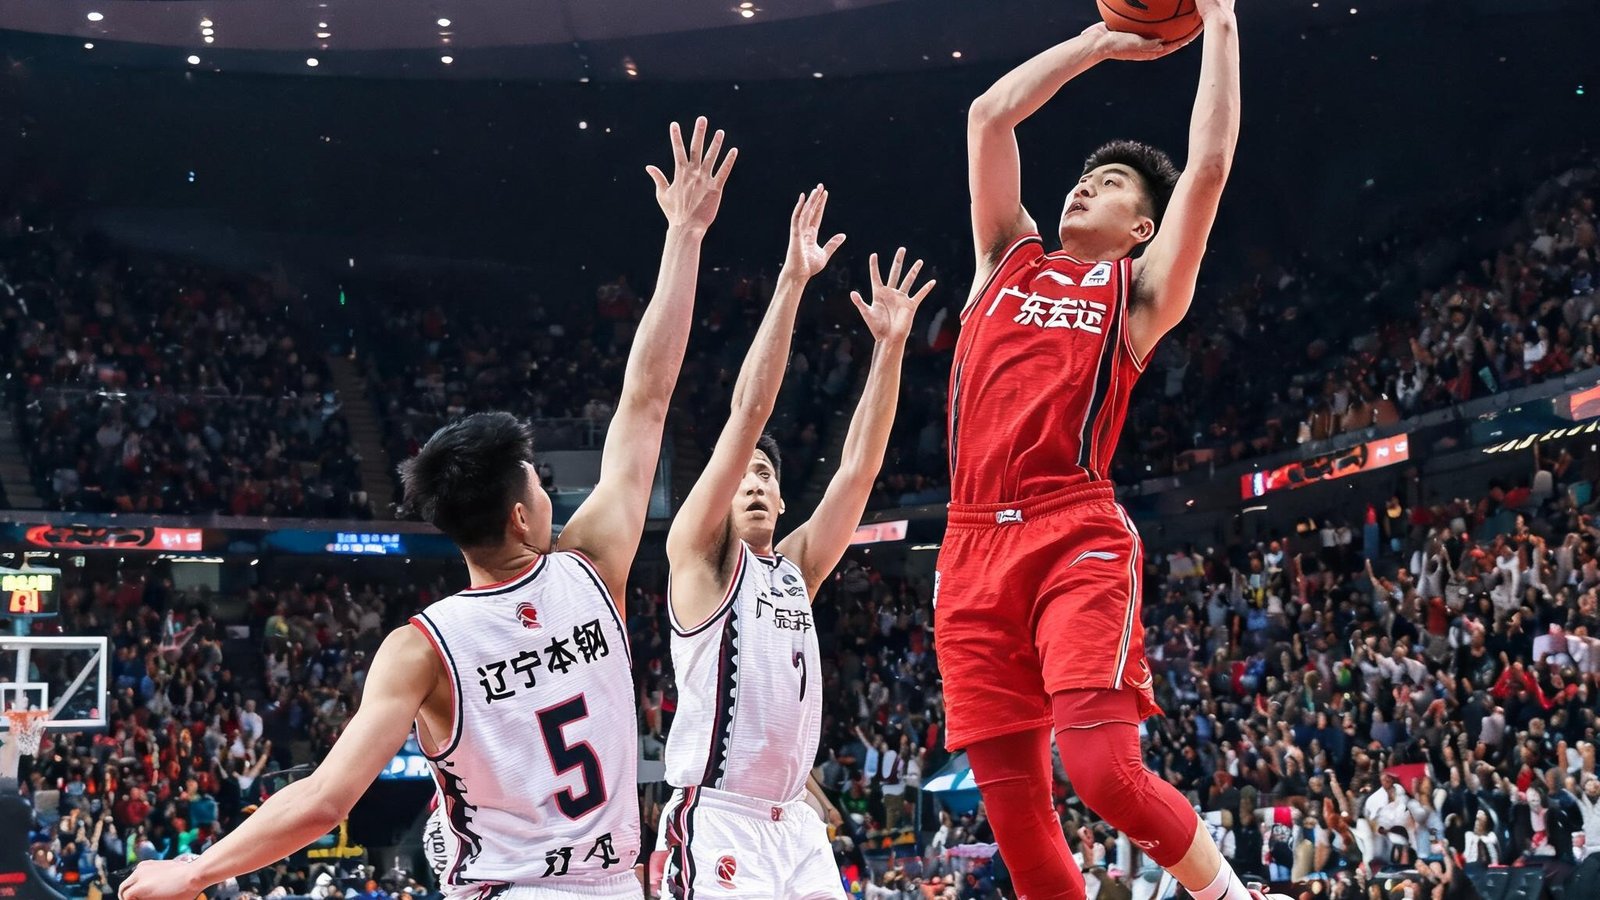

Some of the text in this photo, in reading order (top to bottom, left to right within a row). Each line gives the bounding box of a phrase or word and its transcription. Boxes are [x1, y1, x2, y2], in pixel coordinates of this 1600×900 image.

[476, 618, 610, 705] 辽宁本钢
[534, 692, 608, 821] 5
